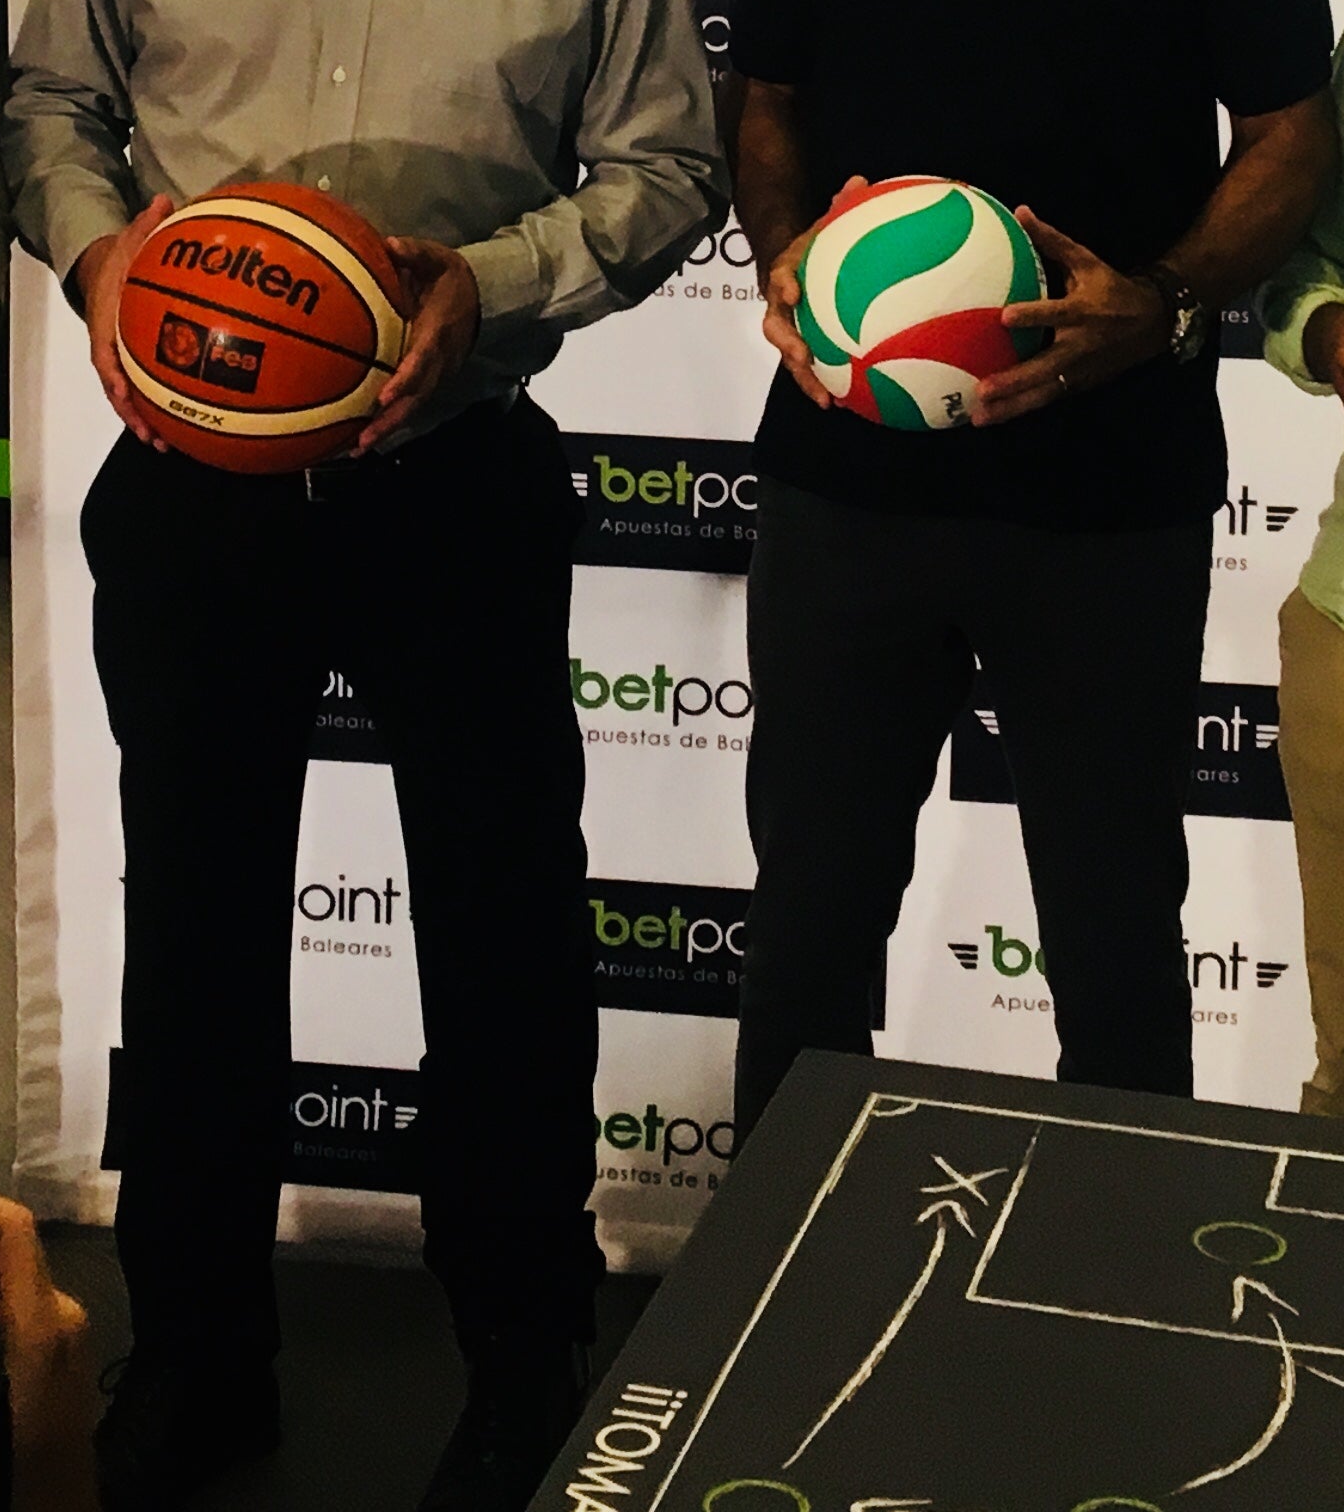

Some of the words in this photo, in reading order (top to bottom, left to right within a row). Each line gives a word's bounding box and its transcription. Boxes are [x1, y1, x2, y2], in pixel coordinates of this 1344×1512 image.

[160, 238, 321, 316] molten
[594, 455, 758, 516] betpo
[601, 518, 690, 538] Apuestas
[701, 522, 726, 540] de
[570, 659, 753, 726] betpo
[586, 729, 670, 749] puestas
[681, 731, 708, 750] de
[301, 937, 393, 958] Baleares
[589, 900, 746, 961] betpo
[594, 960, 683, 983] Apuestas
[694, 967, 718, 983] de
